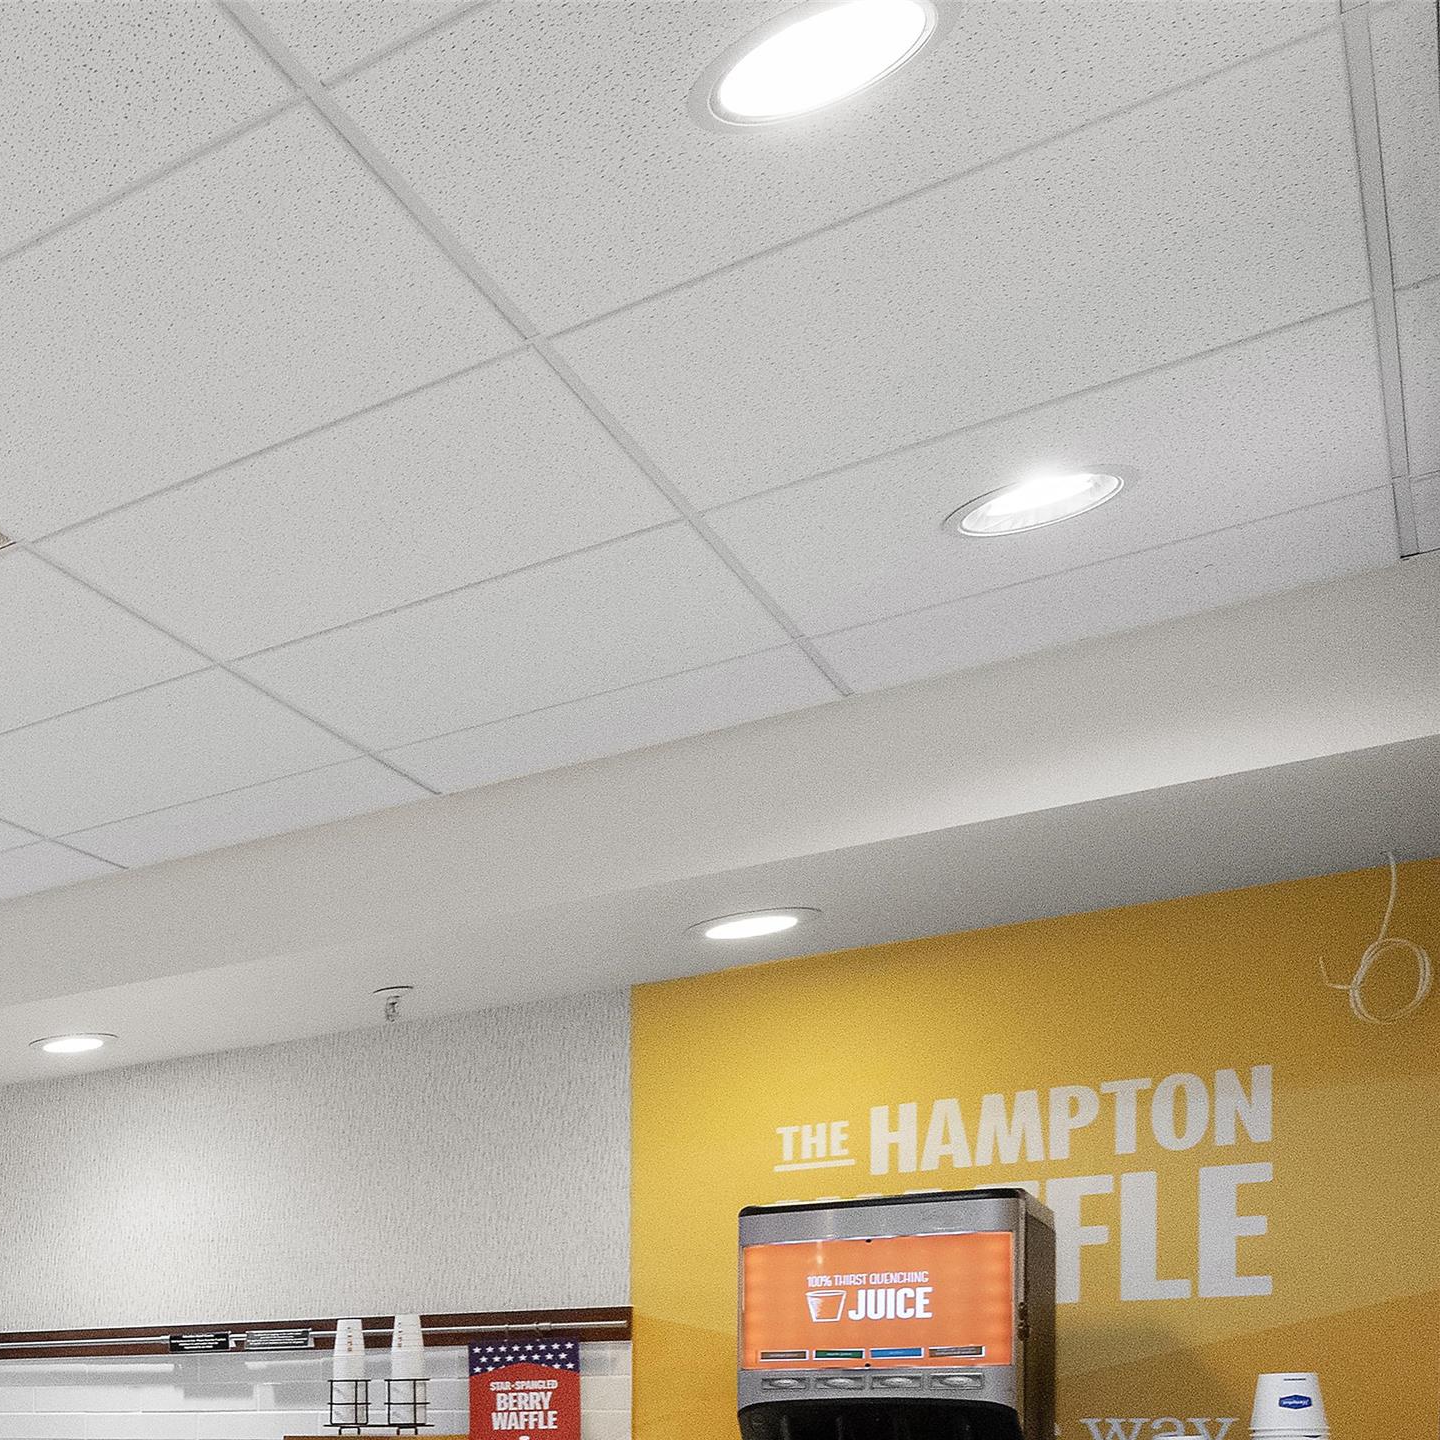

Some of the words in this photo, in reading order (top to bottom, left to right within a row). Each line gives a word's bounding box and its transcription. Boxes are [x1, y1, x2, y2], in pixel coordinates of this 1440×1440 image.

[776, 1121, 849, 1162] THE
[870, 1065, 1273, 1176] HAMPTON
[807, 1275, 832, 1287] 100%
[834, 1274, 868, 1286] THIRST
[869, 1271, 929, 1285] QUENCHING
[848, 1287, 933, 1320] JUICE
[496, 1391, 552, 1411] BERRY
[491, 1411, 559, 1431] WAFFLE
